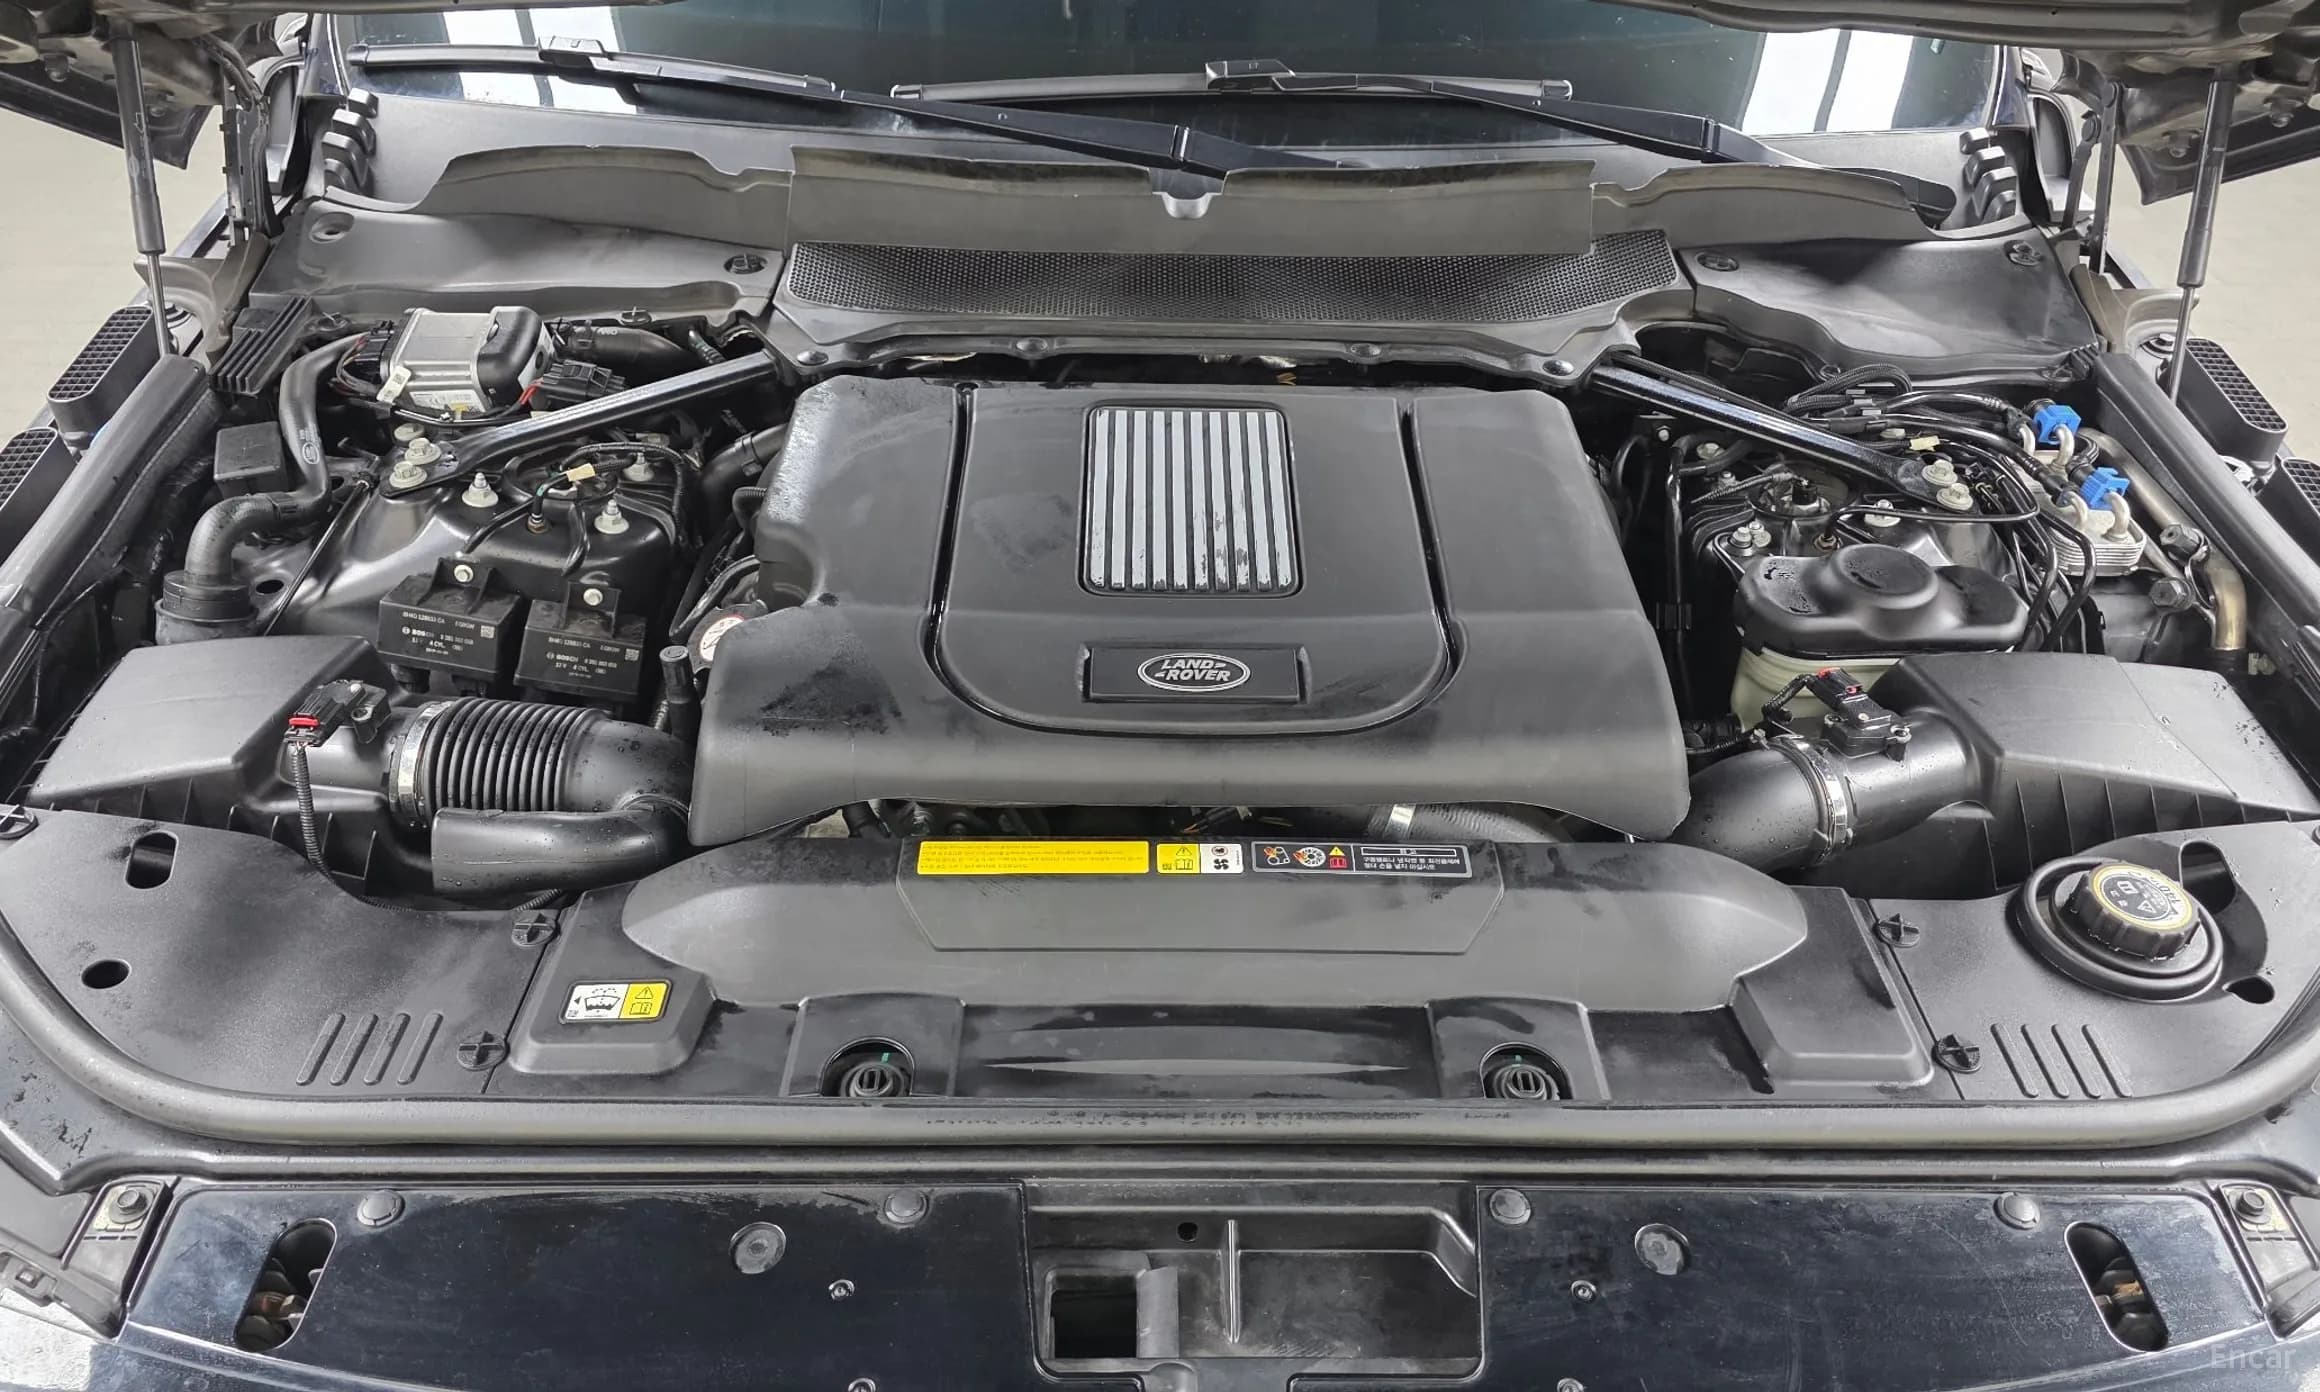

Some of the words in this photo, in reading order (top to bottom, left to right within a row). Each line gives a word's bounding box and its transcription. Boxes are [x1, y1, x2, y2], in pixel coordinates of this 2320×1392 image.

[412, 629, 434, 638] BOSCH
[556, 654, 579, 662] BOSCH
[1161, 659, 1216, 670] LAND
[1166, 669, 1231, 681] ROVER
